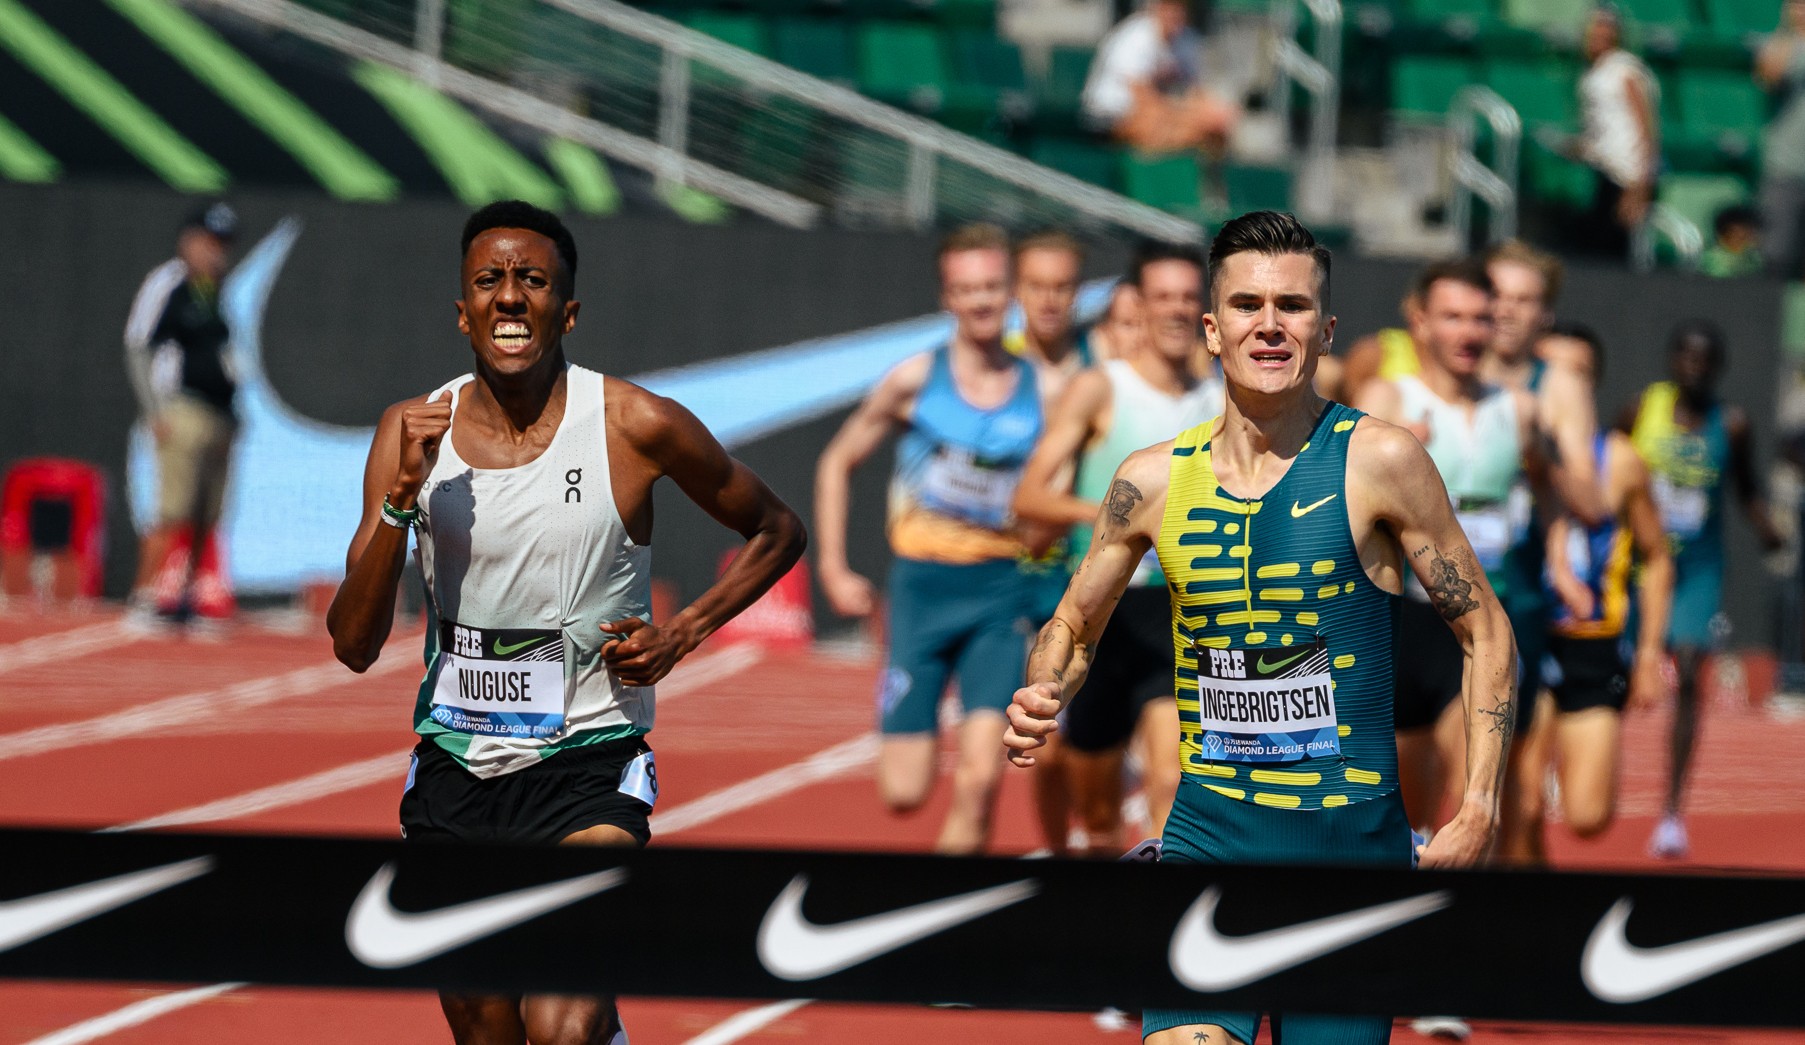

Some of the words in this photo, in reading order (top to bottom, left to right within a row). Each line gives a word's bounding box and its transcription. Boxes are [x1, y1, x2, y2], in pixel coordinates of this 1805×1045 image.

[453, 625, 483, 658] PRE
[1209, 648, 1247, 679] PRE
[459, 667, 532, 702] NUGUSE
[1202, 684, 1330, 723] INGEBRIGTSEN
[452, 720, 494, 733] DIAMOND
[495, 723, 532, 734] LEAGUE
[1223, 744, 1265, 755] DIAMOND
[1266, 743, 1305, 755] LEAGUE
[1306, 739, 1336, 752] FINAL
